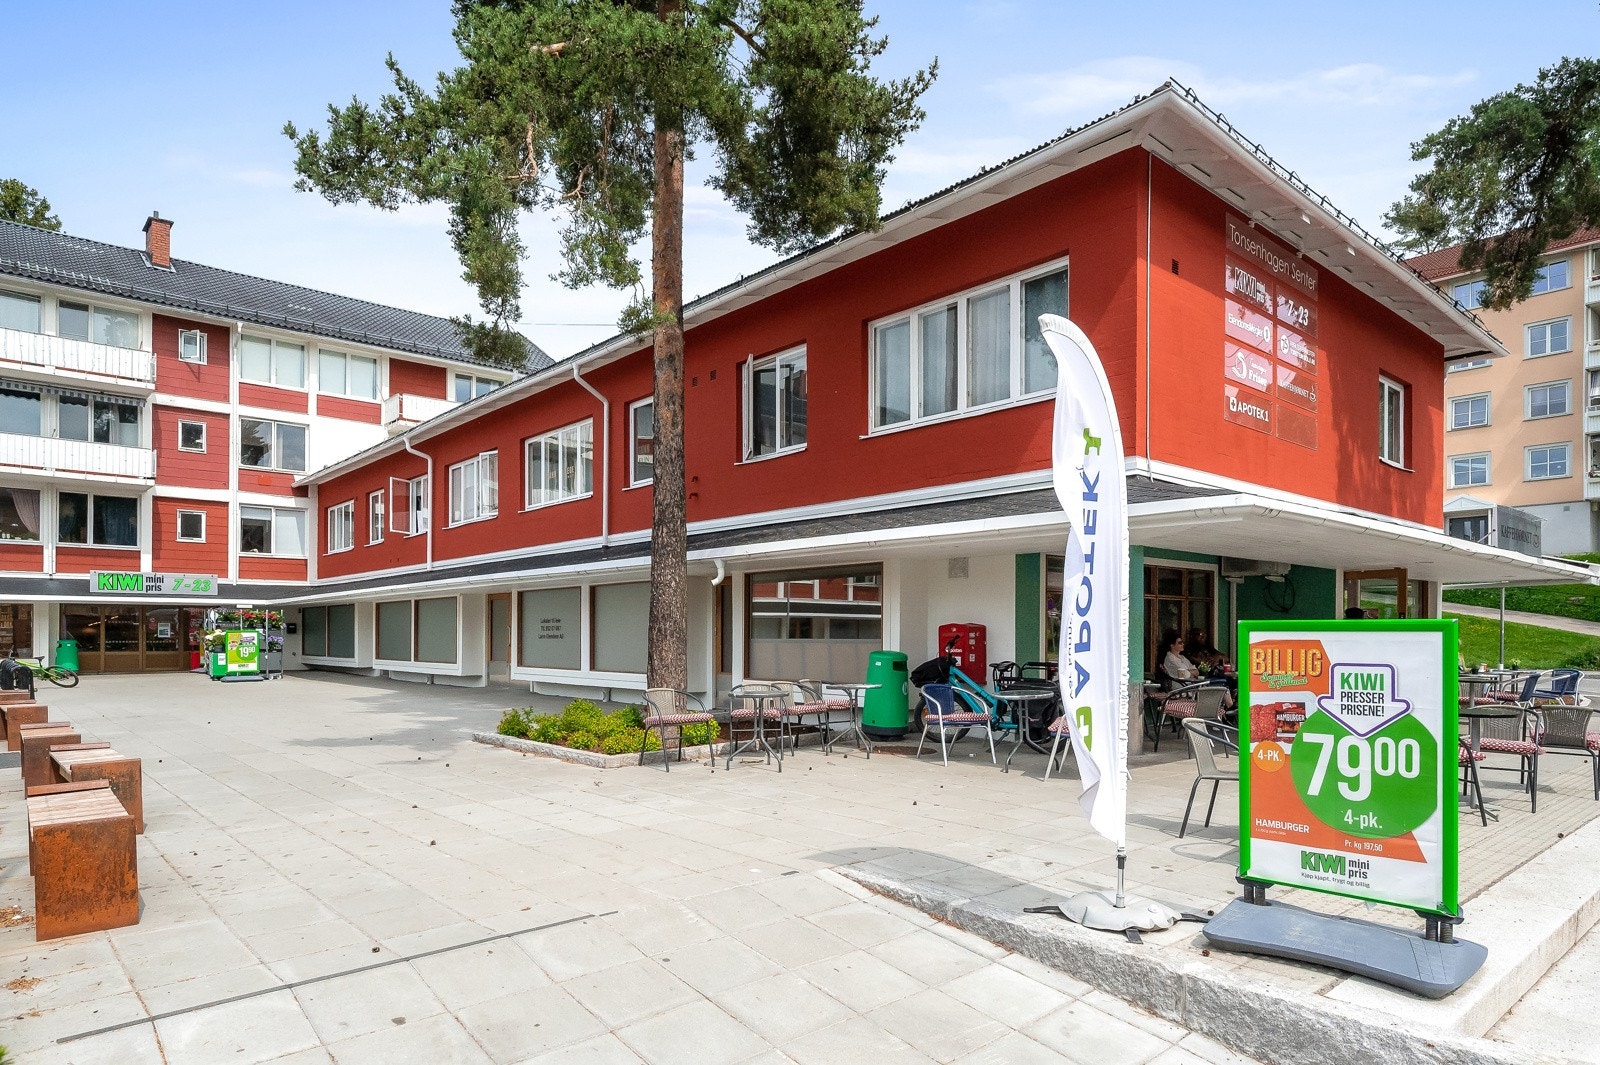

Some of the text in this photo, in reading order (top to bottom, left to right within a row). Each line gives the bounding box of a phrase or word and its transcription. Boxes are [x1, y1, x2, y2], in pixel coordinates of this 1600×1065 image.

[1229, 223, 1316, 291] Tonsenhagen Senter
[1234, 267, 1256, 299] KIWI
[98, 572, 143, 591] KIWI
[145, 573, 164, 584] mini
[145, 582, 162, 593] pris
[1252, 647, 1323, 677] BILLIG
[1340, 672, 1384, 691] KIWI
[1340, 691, 1384, 704] PRESSER
[1340, 704, 1384, 717] PRISENE!
[1257, 749, 1282, 762] 4-PK.
[1255, 818, 1310, 834] HAMBURGER
[1343, 808, 1383, 829] 4-pk.
[1344, 839, 1383, 852] Pr. kg 197,50
[1300, 850, 1370, 876] KIWI mini
[1348, 869, 1368, 880] pris
